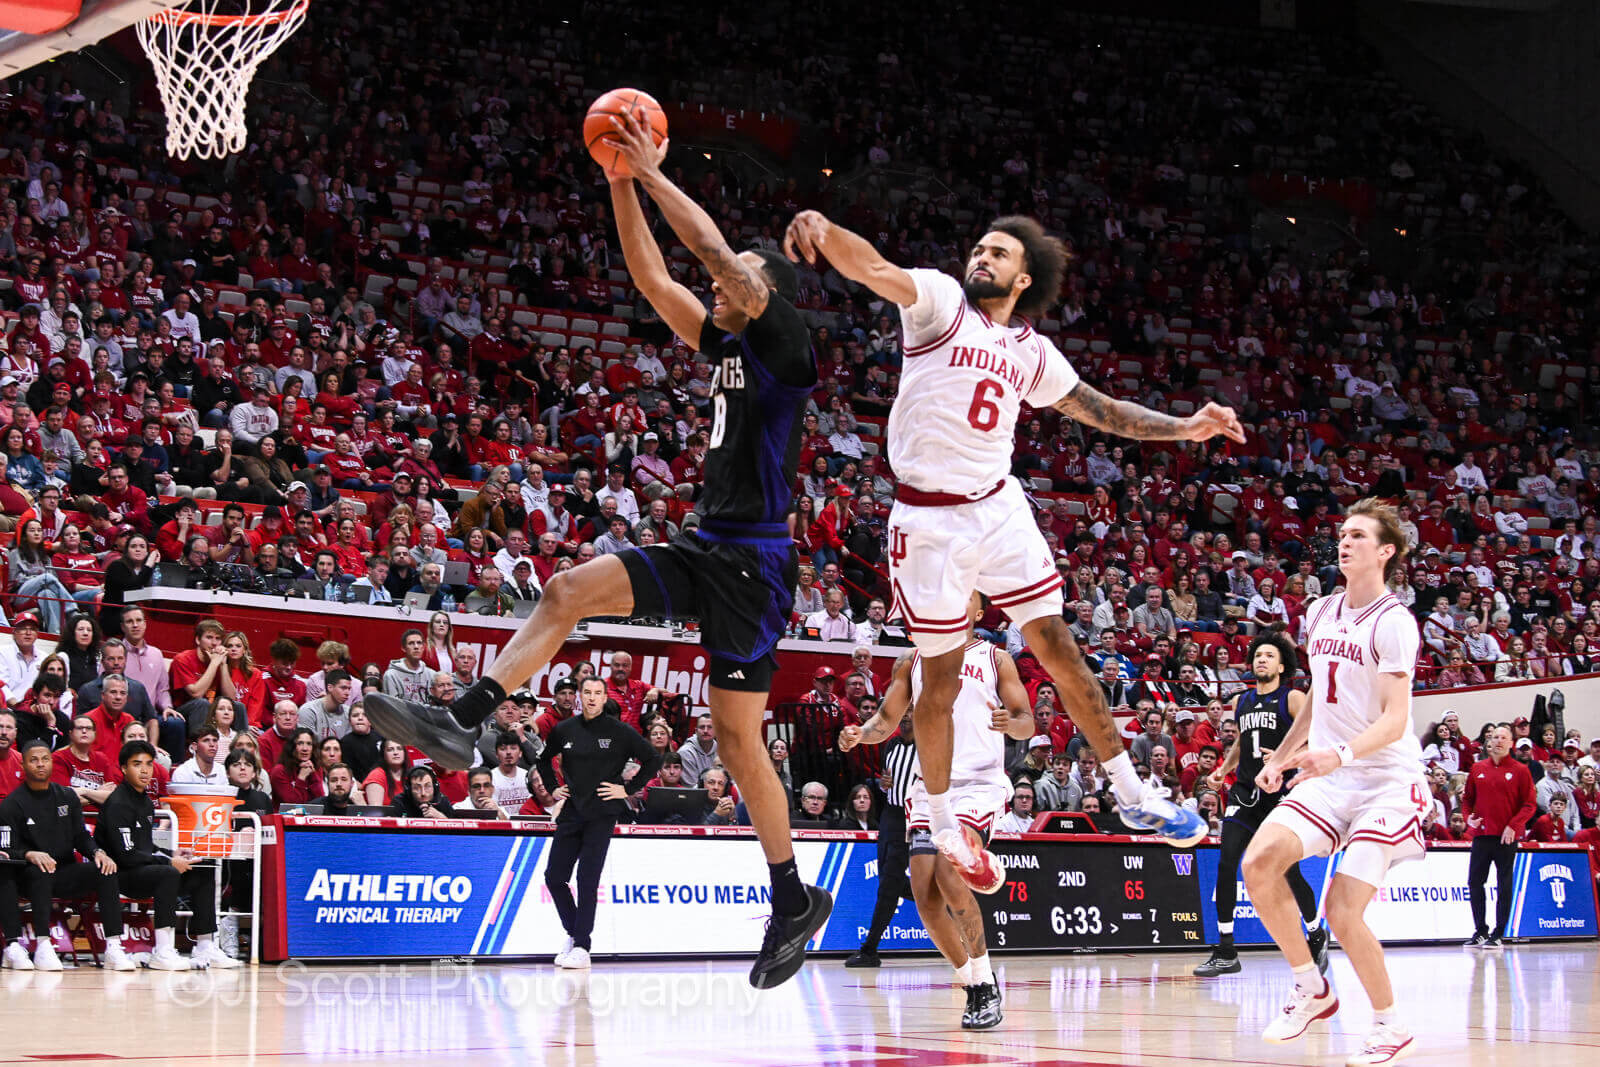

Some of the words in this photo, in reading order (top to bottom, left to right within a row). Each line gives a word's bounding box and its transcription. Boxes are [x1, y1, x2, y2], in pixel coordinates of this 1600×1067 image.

[726, 114, 736, 128] E
[967, 378, 1005, 432] 6
[1312, 638, 1365, 666] INDIANA
[1326, 661, 1340, 704] 1
[1239, 711, 1277, 733] DAWGS
[1251, 730, 1262, 758] 1
[205, 806, 223, 826] G
[1123, 855, 1144, 870] UW
[1171, 853, 1194, 876] W
[1058, 871, 1086, 887] 2ND
[1539, 863, 1574, 882] INDIANA
[304, 868, 473, 903] ATHLETICO
[611, 884, 660, 904] LIKE
[664, 884, 708, 904] YOU
[1006, 881, 1028, 902] 78
[1125, 880, 1145, 900] 65
[1390, 886, 1419, 902] LIKE
[1422, 886, 1448, 902] YOU
[315, 907, 390, 923] PHYSICAL
[394, 907, 463, 923] THERAPY
[992, 910, 1008, 925] 10
[1050, 906, 1103, 935] 6:33
[1149, 909, 1158, 922] 7
[1171, 912, 1198, 922] FOULS
[1538, 918, 1560, 929] Proud
[1560, 918, 1586, 929] Partner
[893, 926, 930, 940] Partne
[998, 932, 1006, 946] 3
[1151, 930, 1160, 943] 2
[1183, 930, 1200, 940] TOL
